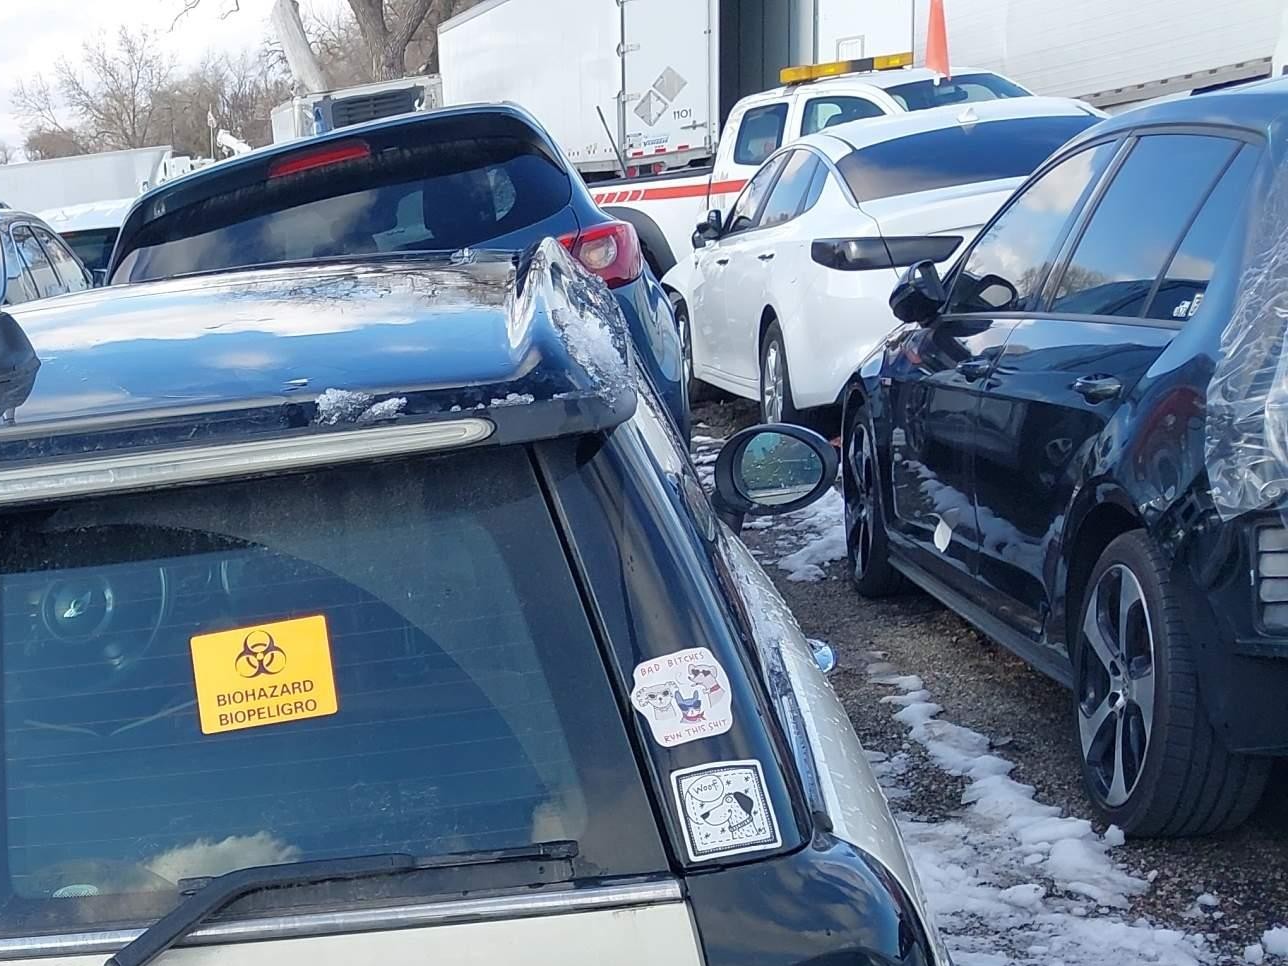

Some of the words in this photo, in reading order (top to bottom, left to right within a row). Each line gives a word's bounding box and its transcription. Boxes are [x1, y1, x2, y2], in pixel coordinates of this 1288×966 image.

[673, 109, 692, 120] 1101
[640, 663, 661, 677] BAD
[667, 651, 704, 667] BITCHES
[216, 680, 314, 707] BIOHAZARD
[218, 699, 318, 726] BIOPELIGRO
[664, 733, 682, 743] RUN
[685, 723, 706, 737] THIS
[708, 719, 727, 731] SHIT
